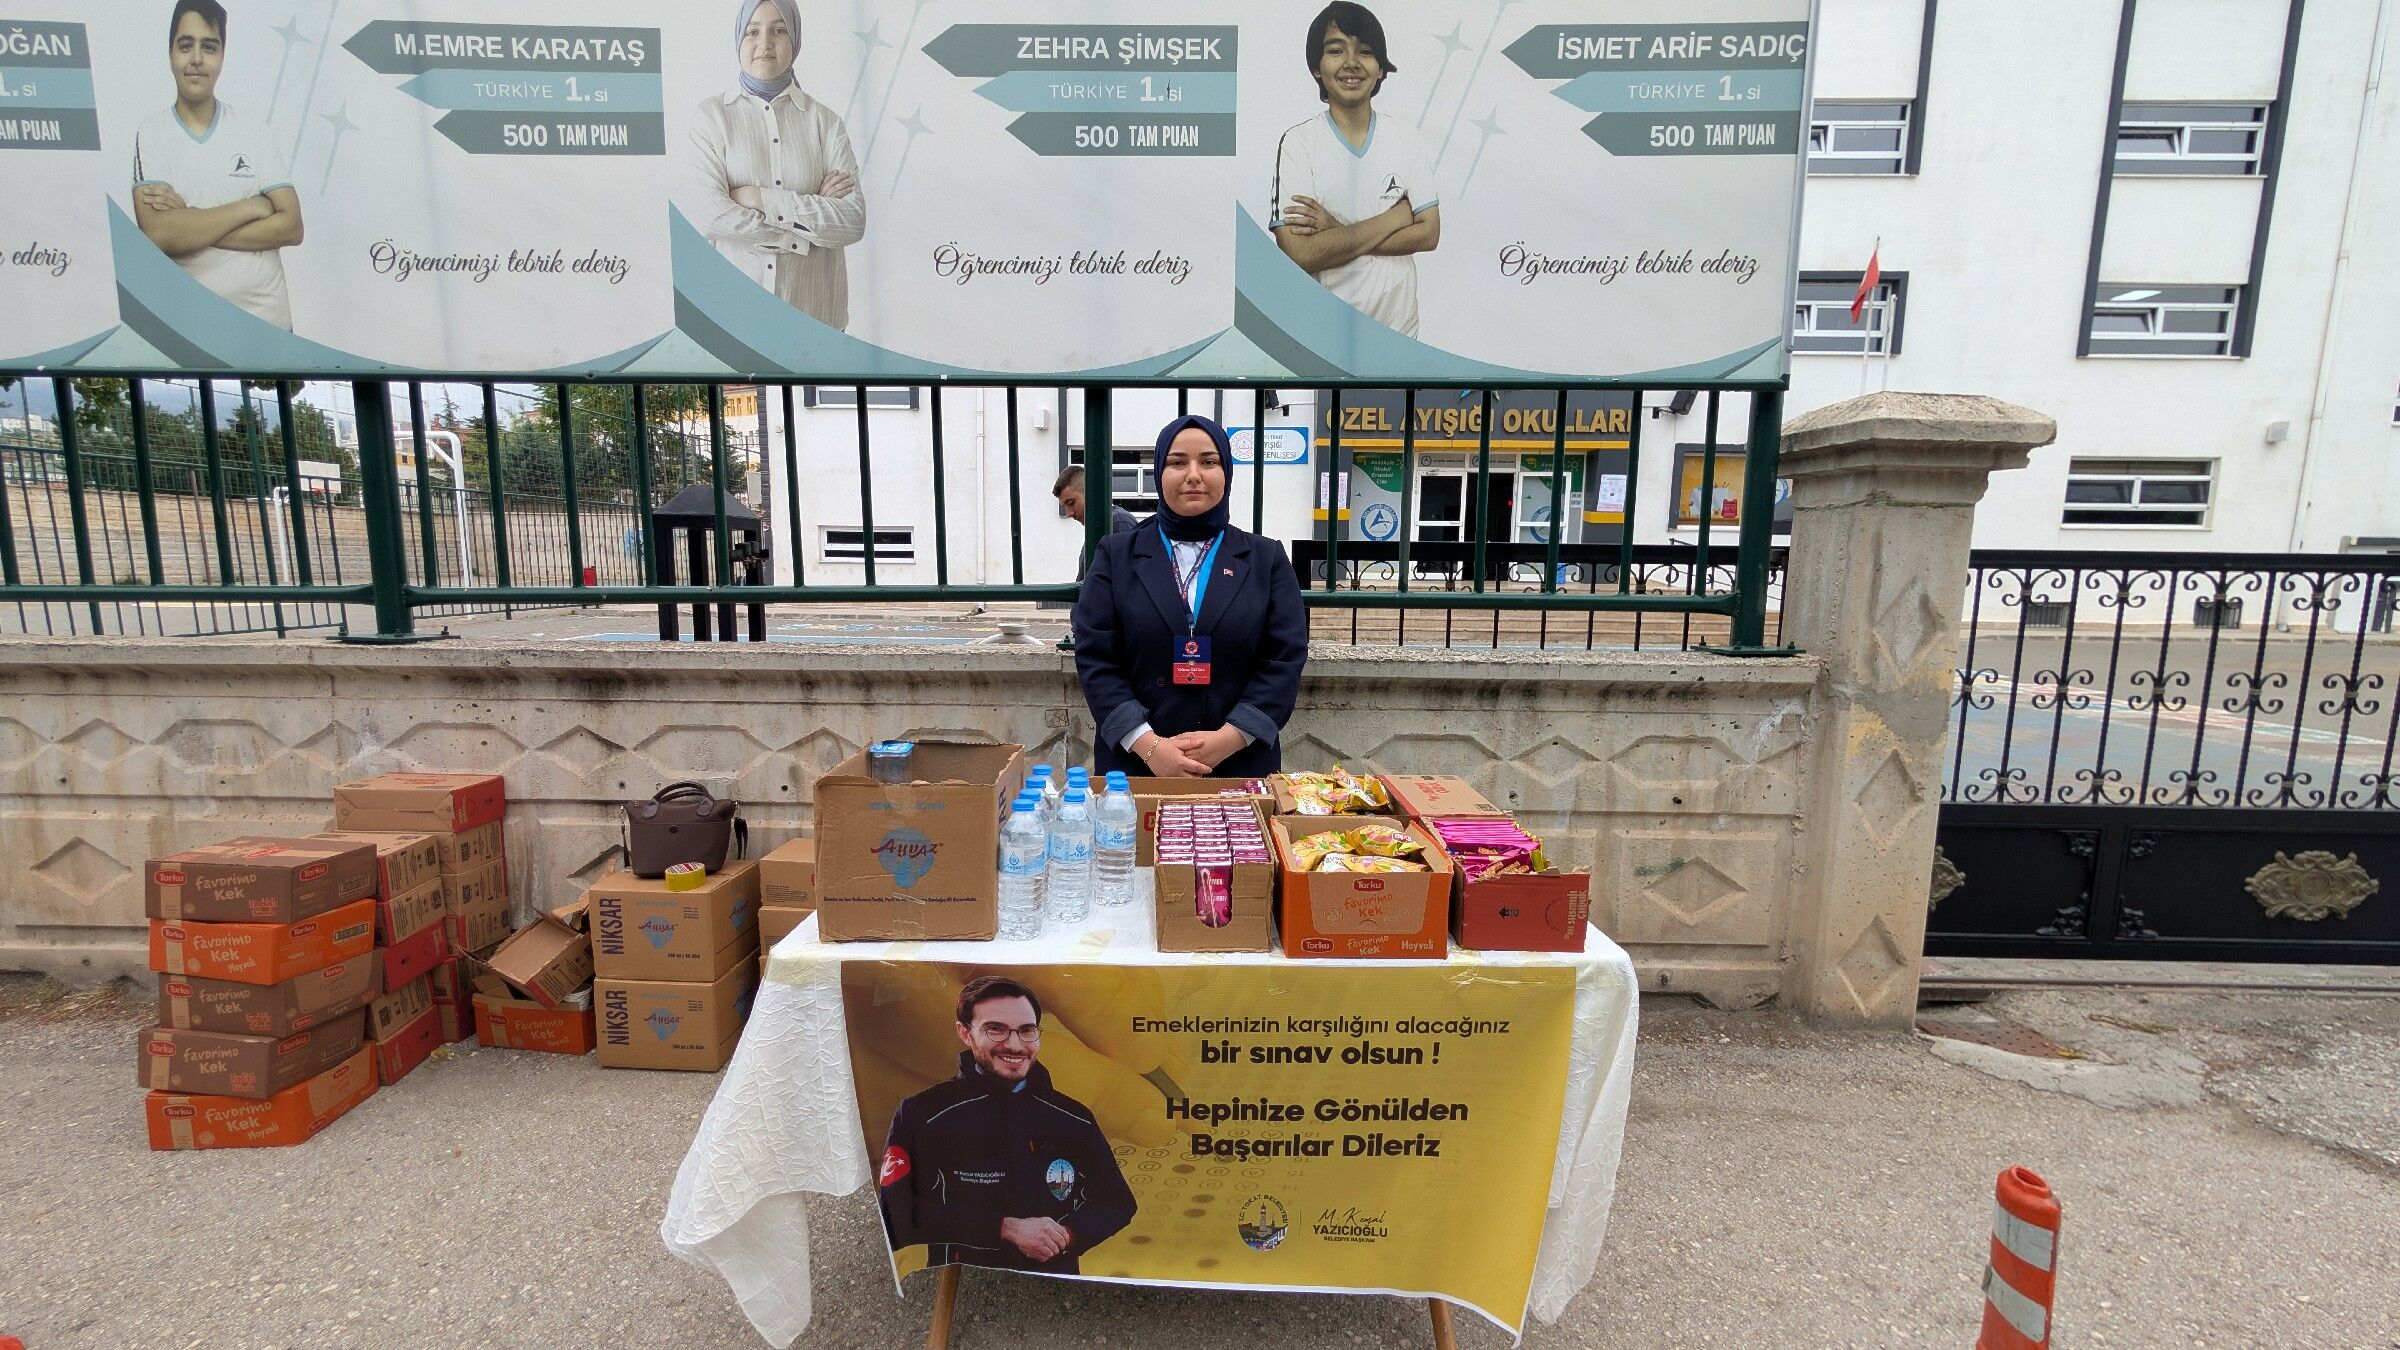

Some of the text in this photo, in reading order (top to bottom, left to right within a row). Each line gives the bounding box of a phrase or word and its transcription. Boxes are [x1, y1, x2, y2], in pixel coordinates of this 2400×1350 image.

[394, 33, 646, 67] M.EMRE KARATAŞ
[1017, 33, 1222, 66] ZEHRA ŞİMŞEK
[1557, 31, 1806, 63] İSMET ARİF SADIÇ
[473, 81, 553, 99] TÜRKİYE
[1049, 82, 1128, 100] TÜRKİYE
[1628, 82, 1707, 100] TÜRKİYE
[0, 119, 62, 141] AM PUAN
[503, 124, 629, 147] 500 TAM PUAN
[1075, 125, 1200, 148] 500 TAM PUAN
[1650, 123, 1777, 147] 500 TAM PUAN
[12, 241, 72, 277] ederiz
[369, 238, 632, 285] Öğrencimizi tebrik ederiz
[933, 241, 1194, 286] Öğrencimizi tebrik ederiz
[1499, 240, 1761, 286] Öğrencimizi tebrik ederiz
[158, 872, 184, 883] Torku
[1356, 880, 1382, 889] Torku
[164, 929, 185, 940] Torku
[596, 897, 625, 955] NİKSAR
[1305, 941, 1330, 950] Torku
[1401, 938, 1434, 953] Meyveli
[169, 984, 191, 995] Torku
[601, 990, 630, 1046] NİKSAR
[1132, 1016, 1510, 1038] Emeklerinizin karşılığını alacağınız
[151, 1044, 174, 1054] Torku
[1201, 1040, 1440, 1065] bir sınav olsun !
[167, 1107, 193, 1116] Torku
[1166, 1097, 1468, 1127] Hepinize Gönülden
[1191, 1133, 1441, 1162] Başarılar Dileriz
[1241, 1194, 1262, 1210] TOKAT
[1313, 1224, 1388, 1238] YAZICIOĞLU
